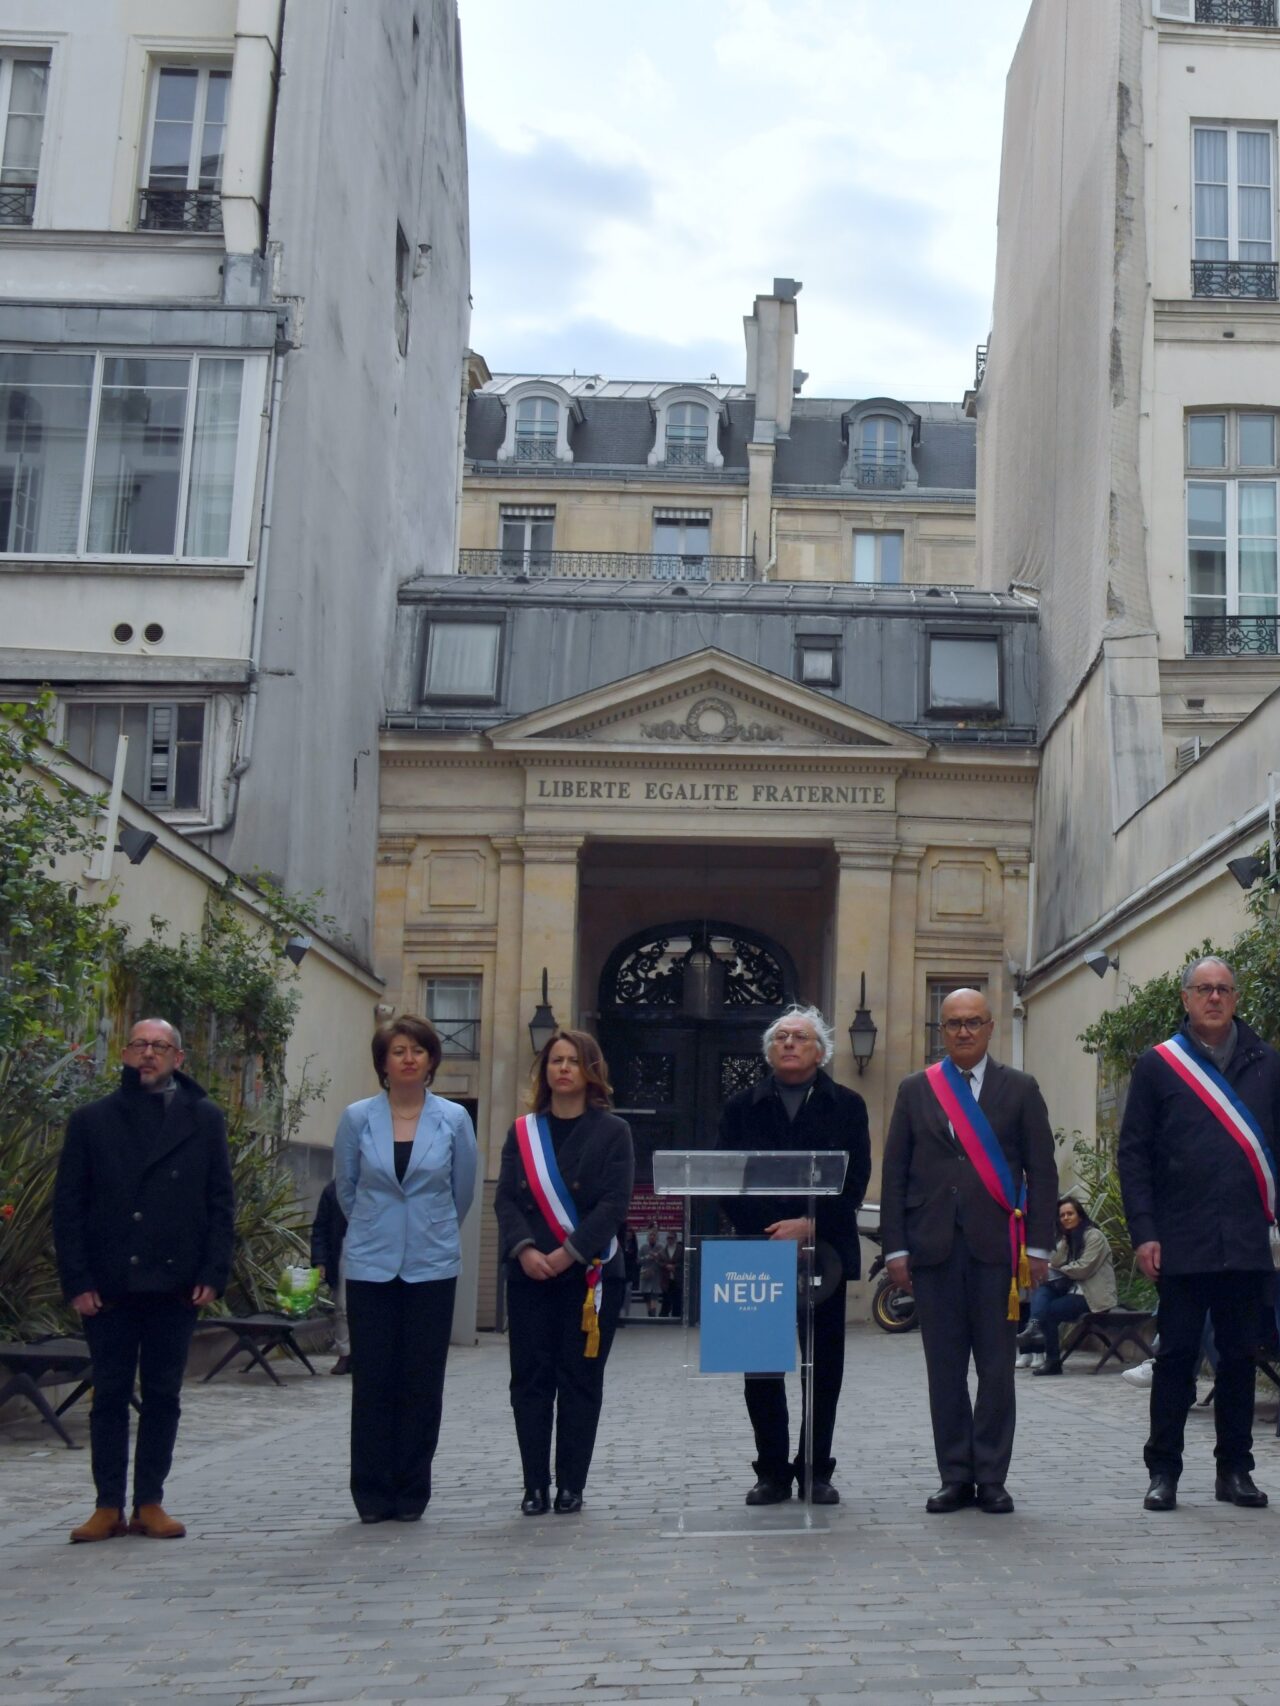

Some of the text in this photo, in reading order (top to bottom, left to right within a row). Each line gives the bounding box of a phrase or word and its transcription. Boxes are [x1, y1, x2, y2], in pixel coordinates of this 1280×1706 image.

[538, 780, 885, 804] LIBERTE EGALITE FRATERNITE
[725, 1271, 771, 1281] Mairie du
[714, 1282, 784, 1303] NEUF
